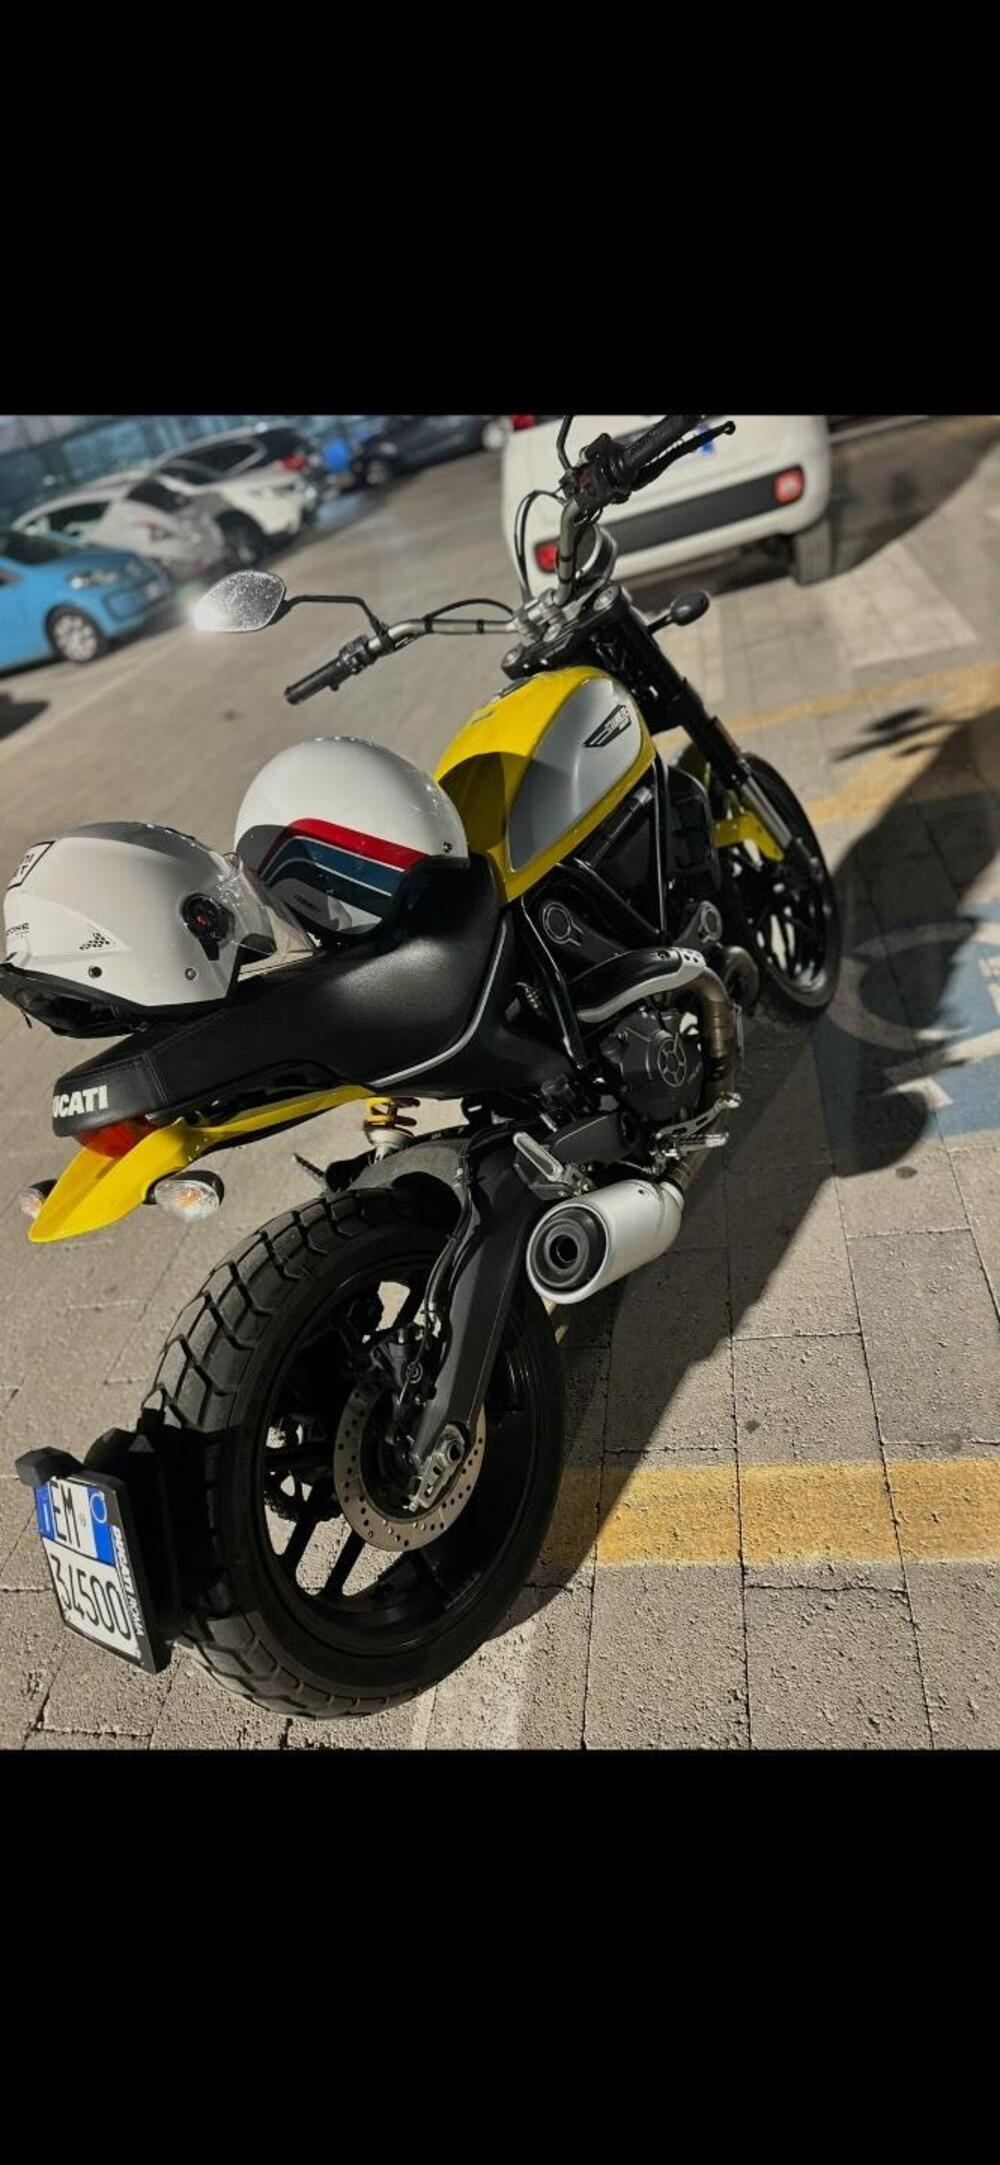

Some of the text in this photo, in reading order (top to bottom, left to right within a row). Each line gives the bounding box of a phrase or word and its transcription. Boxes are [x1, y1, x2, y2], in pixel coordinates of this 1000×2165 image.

[53, 1085, 108, 1118] UCATI
[50, 1480, 81, 1549] EM
[51, 1553, 132, 1641] 34500
